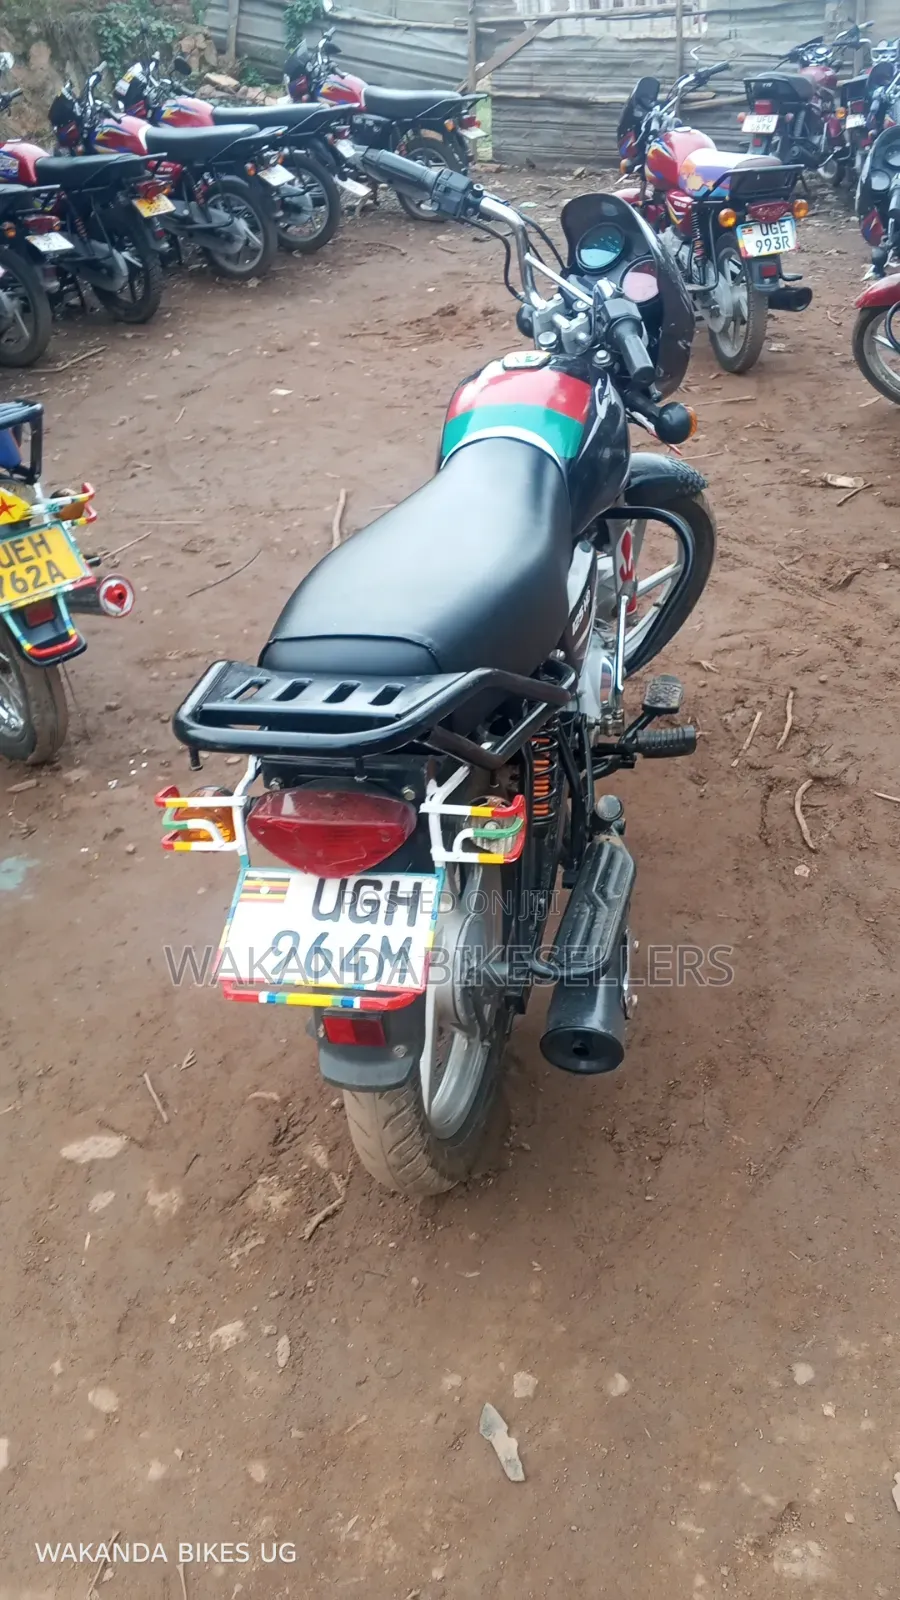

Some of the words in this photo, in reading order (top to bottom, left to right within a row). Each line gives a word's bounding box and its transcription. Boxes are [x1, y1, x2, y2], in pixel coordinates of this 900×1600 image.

[756, 236, 791, 253] 993R
[760, 220, 788, 236] UGE
[311, 878, 422, 927] UGH
[270, 930, 413, 984] 964M
